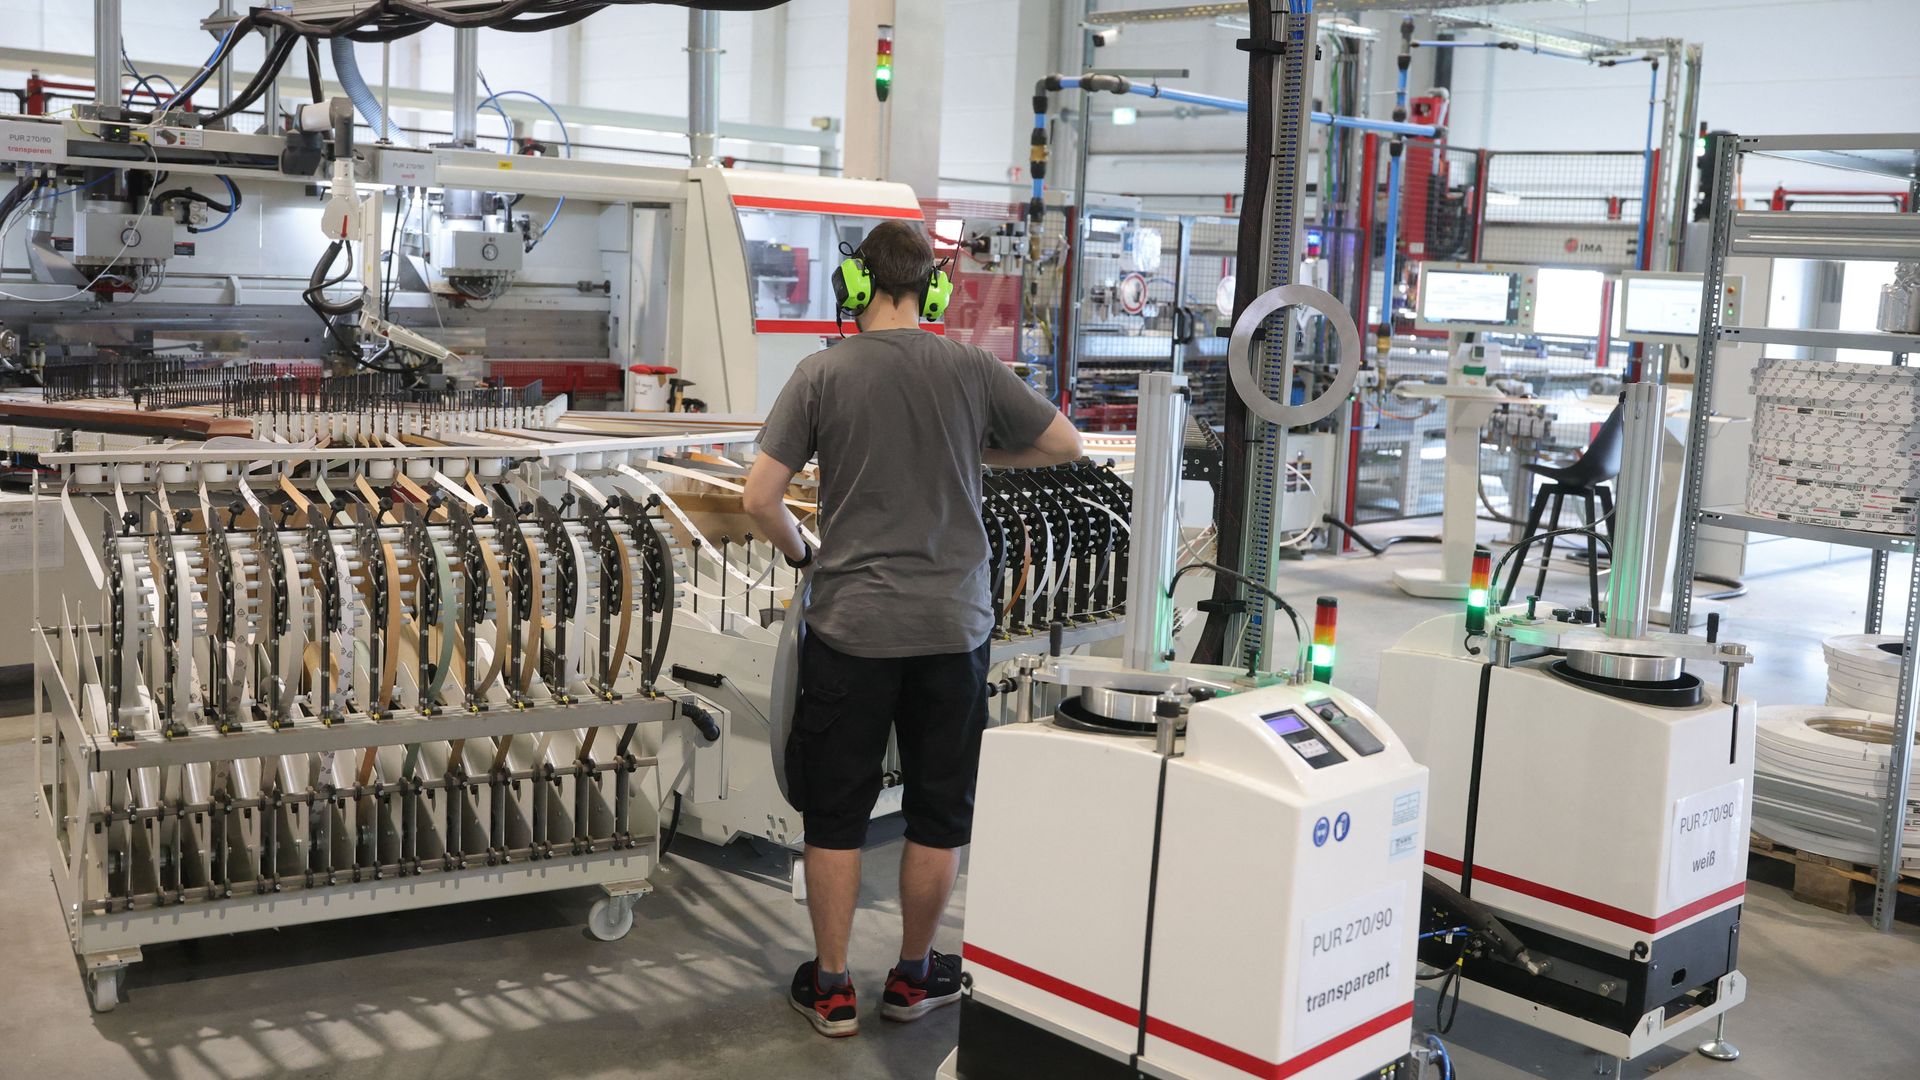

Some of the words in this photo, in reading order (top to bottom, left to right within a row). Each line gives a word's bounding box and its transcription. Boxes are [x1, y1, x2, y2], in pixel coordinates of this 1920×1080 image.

[8, 146, 52, 154] transparent
[1580, 244, 1603, 253] IMA
[1680, 812, 1701, 835] PUR
[1702, 802, 1735, 827] 270/90
[1692, 850, 1716, 873] weiß
[1312, 927, 1343, 957] PUR
[1345, 907, 1393, 943] 270/90
[1306, 961, 1391, 1013] transparent
